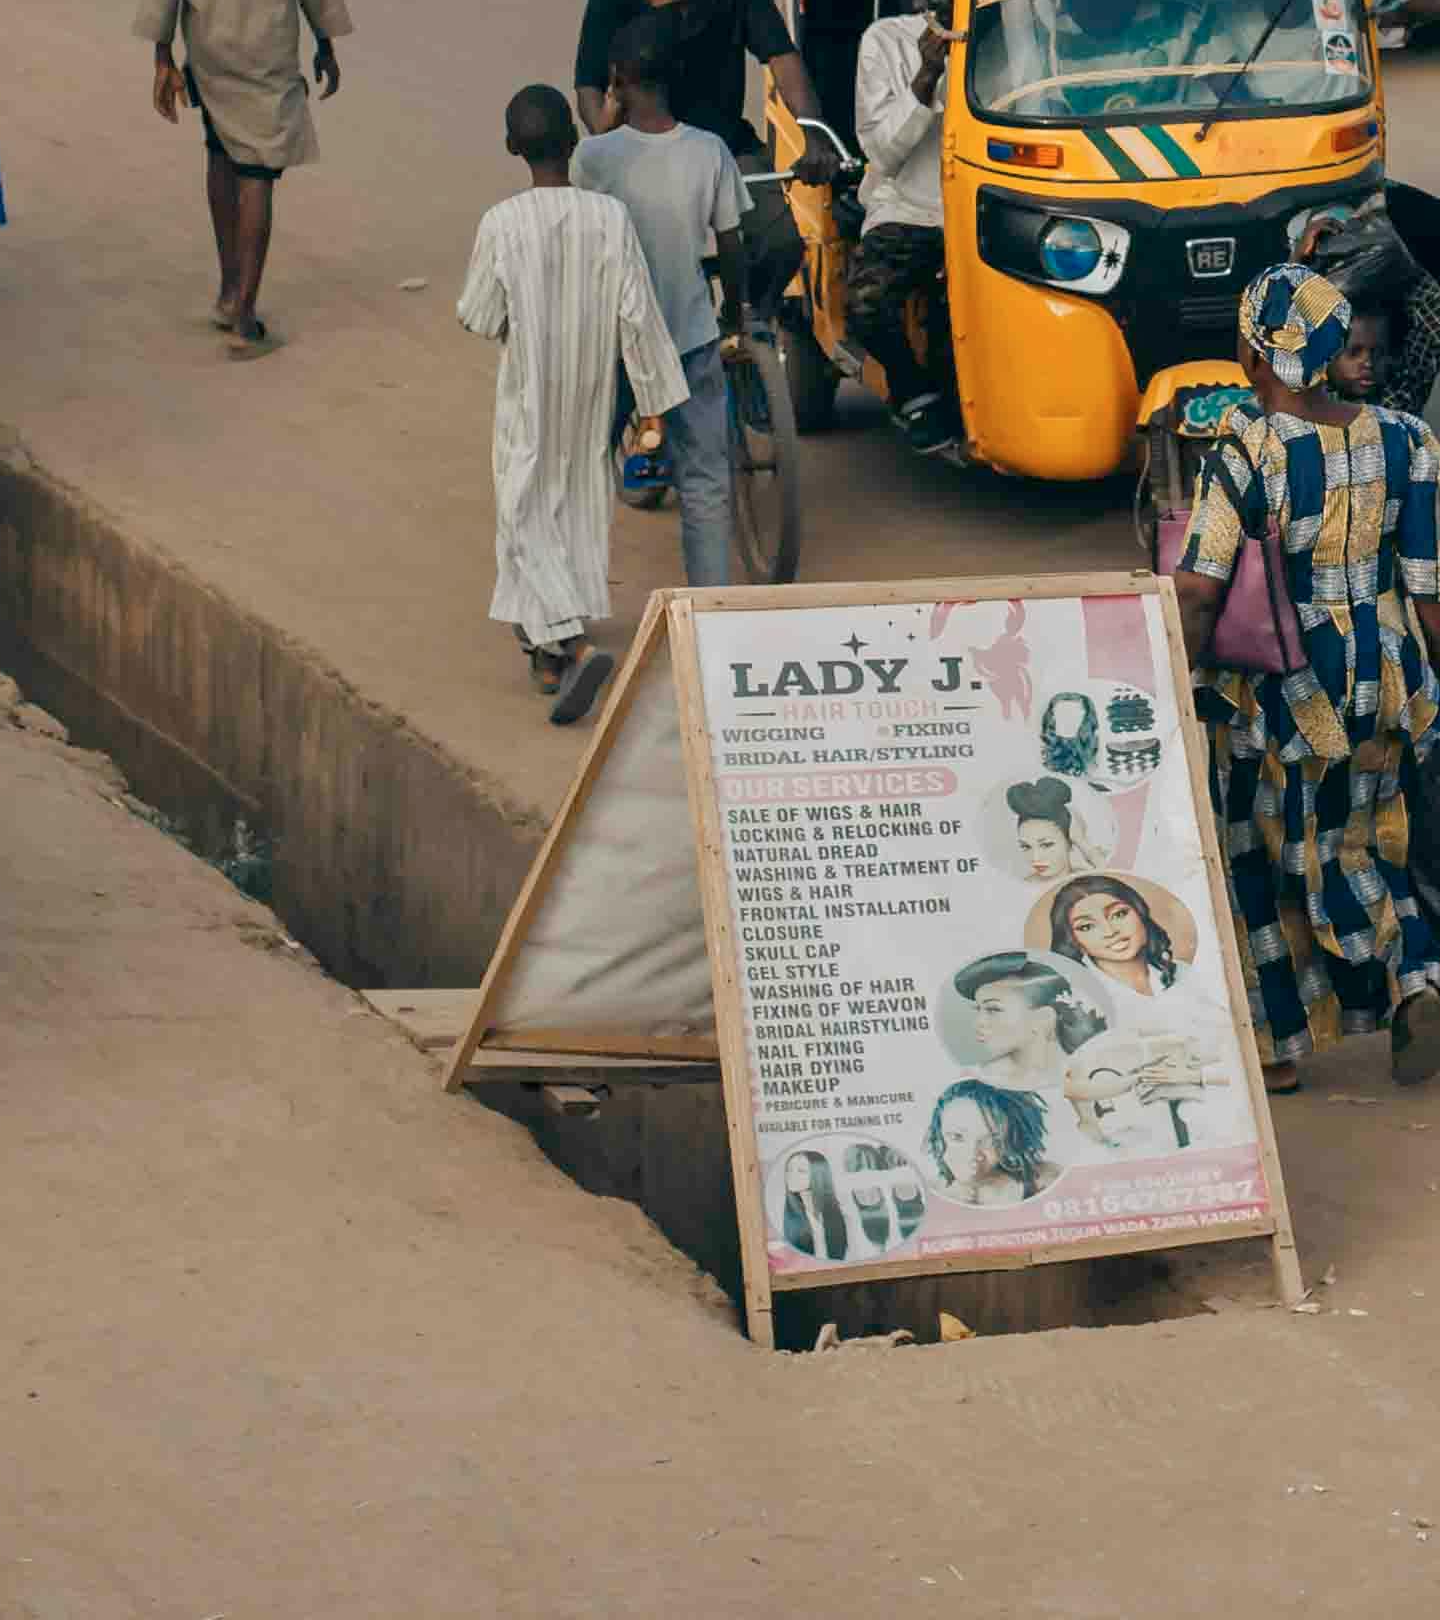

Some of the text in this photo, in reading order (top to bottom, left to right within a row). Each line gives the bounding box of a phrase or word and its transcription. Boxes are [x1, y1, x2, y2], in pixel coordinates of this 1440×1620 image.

[1197, 251, 1227, 269] RE
[729, 657, 983, 698] LADY J.
[784, 700, 937, 721] HAIR TOUCH
[721, 726, 825, 744] WIGGING
[894, 722, 971, 738] FIXING
[723, 744, 974, 767] BRIDAL HAIR/STYLING
[724, 770, 945, 799] OUR SERVICES
[728, 803, 922, 824] SALE OF WIGS & HAIR
[730, 820, 962, 843] LOCKING & RELOCKING OF
[733, 843, 879, 863] NATURAL DREAD
[736, 858, 980, 882] WASHING & TREATMENT OF
[737, 884, 854, 903] WIGS & HAIR
[740, 897, 951, 922] FRONTAL INSTALLATION
[742, 924, 824, 941] CLOSURE
[745, 943, 841, 961] SKULL CAP
[747, 963, 840, 981] GEL STYLE
[750, 978, 915, 1000] WASHING OF HAIR
[753, 996, 927, 1020] FIXING OF WEAVON
[755, 1016, 929, 1040] BRIDAL HAIRSTYLING
[758, 1040, 864, 1060] NAIL FIXING
[760, 1059, 864, 1078] HAIR DYING
[763, 1077, 840, 1096] MAKEUP
[766, 1097, 828, 1111] PEDICURE
[847, 1092, 915, 1106] MANICURE
[884, 1112, 903, 1124] ETC
